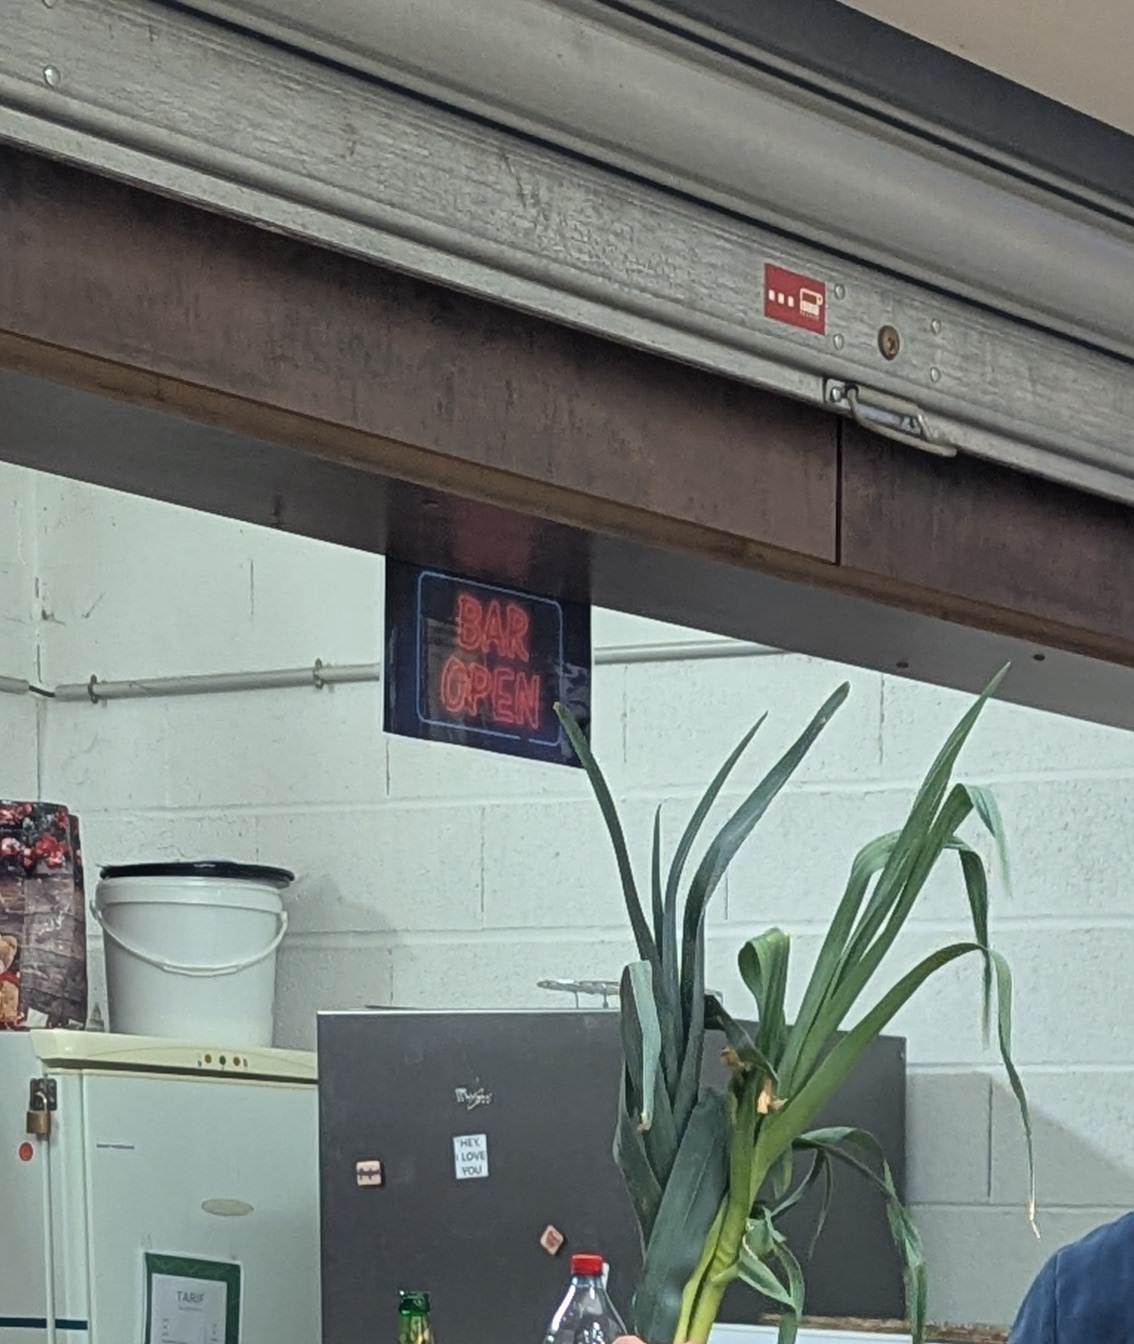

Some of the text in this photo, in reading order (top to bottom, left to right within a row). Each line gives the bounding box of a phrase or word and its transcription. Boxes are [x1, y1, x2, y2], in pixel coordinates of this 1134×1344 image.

[457, 594, 530, 662] BAR
[440, 653, 541, 729] OPEN
[461, 1150, 485, 1162] LOVE
[461, 1165, 482, 1176] YOU
